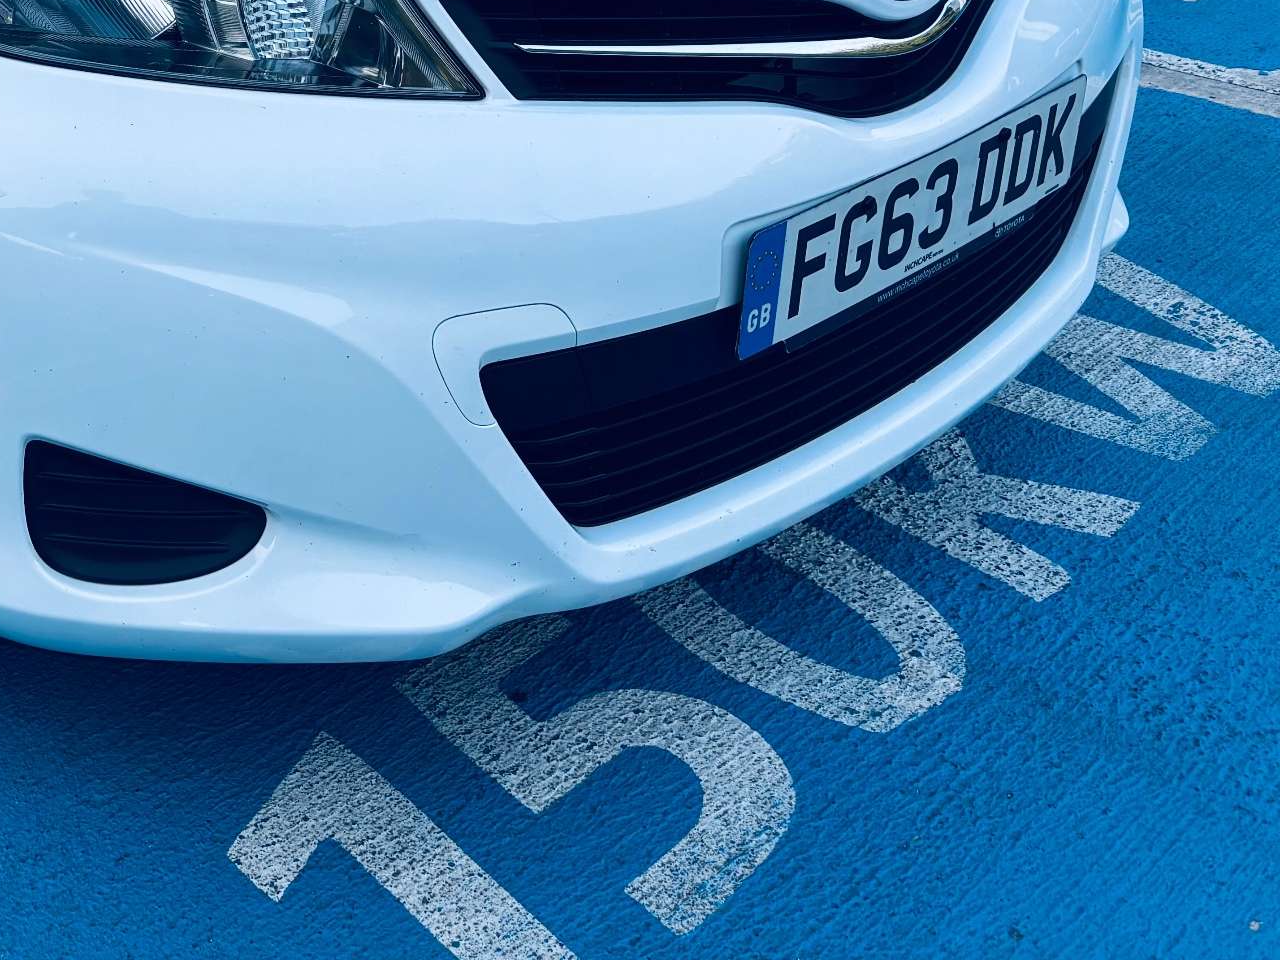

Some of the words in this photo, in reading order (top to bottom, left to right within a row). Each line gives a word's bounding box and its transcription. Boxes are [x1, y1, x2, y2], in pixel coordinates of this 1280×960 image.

[787, 157, 959, 320] FG63
[967, 92, 1077, 226] DDK
[747, 302, 772, 334] GB
